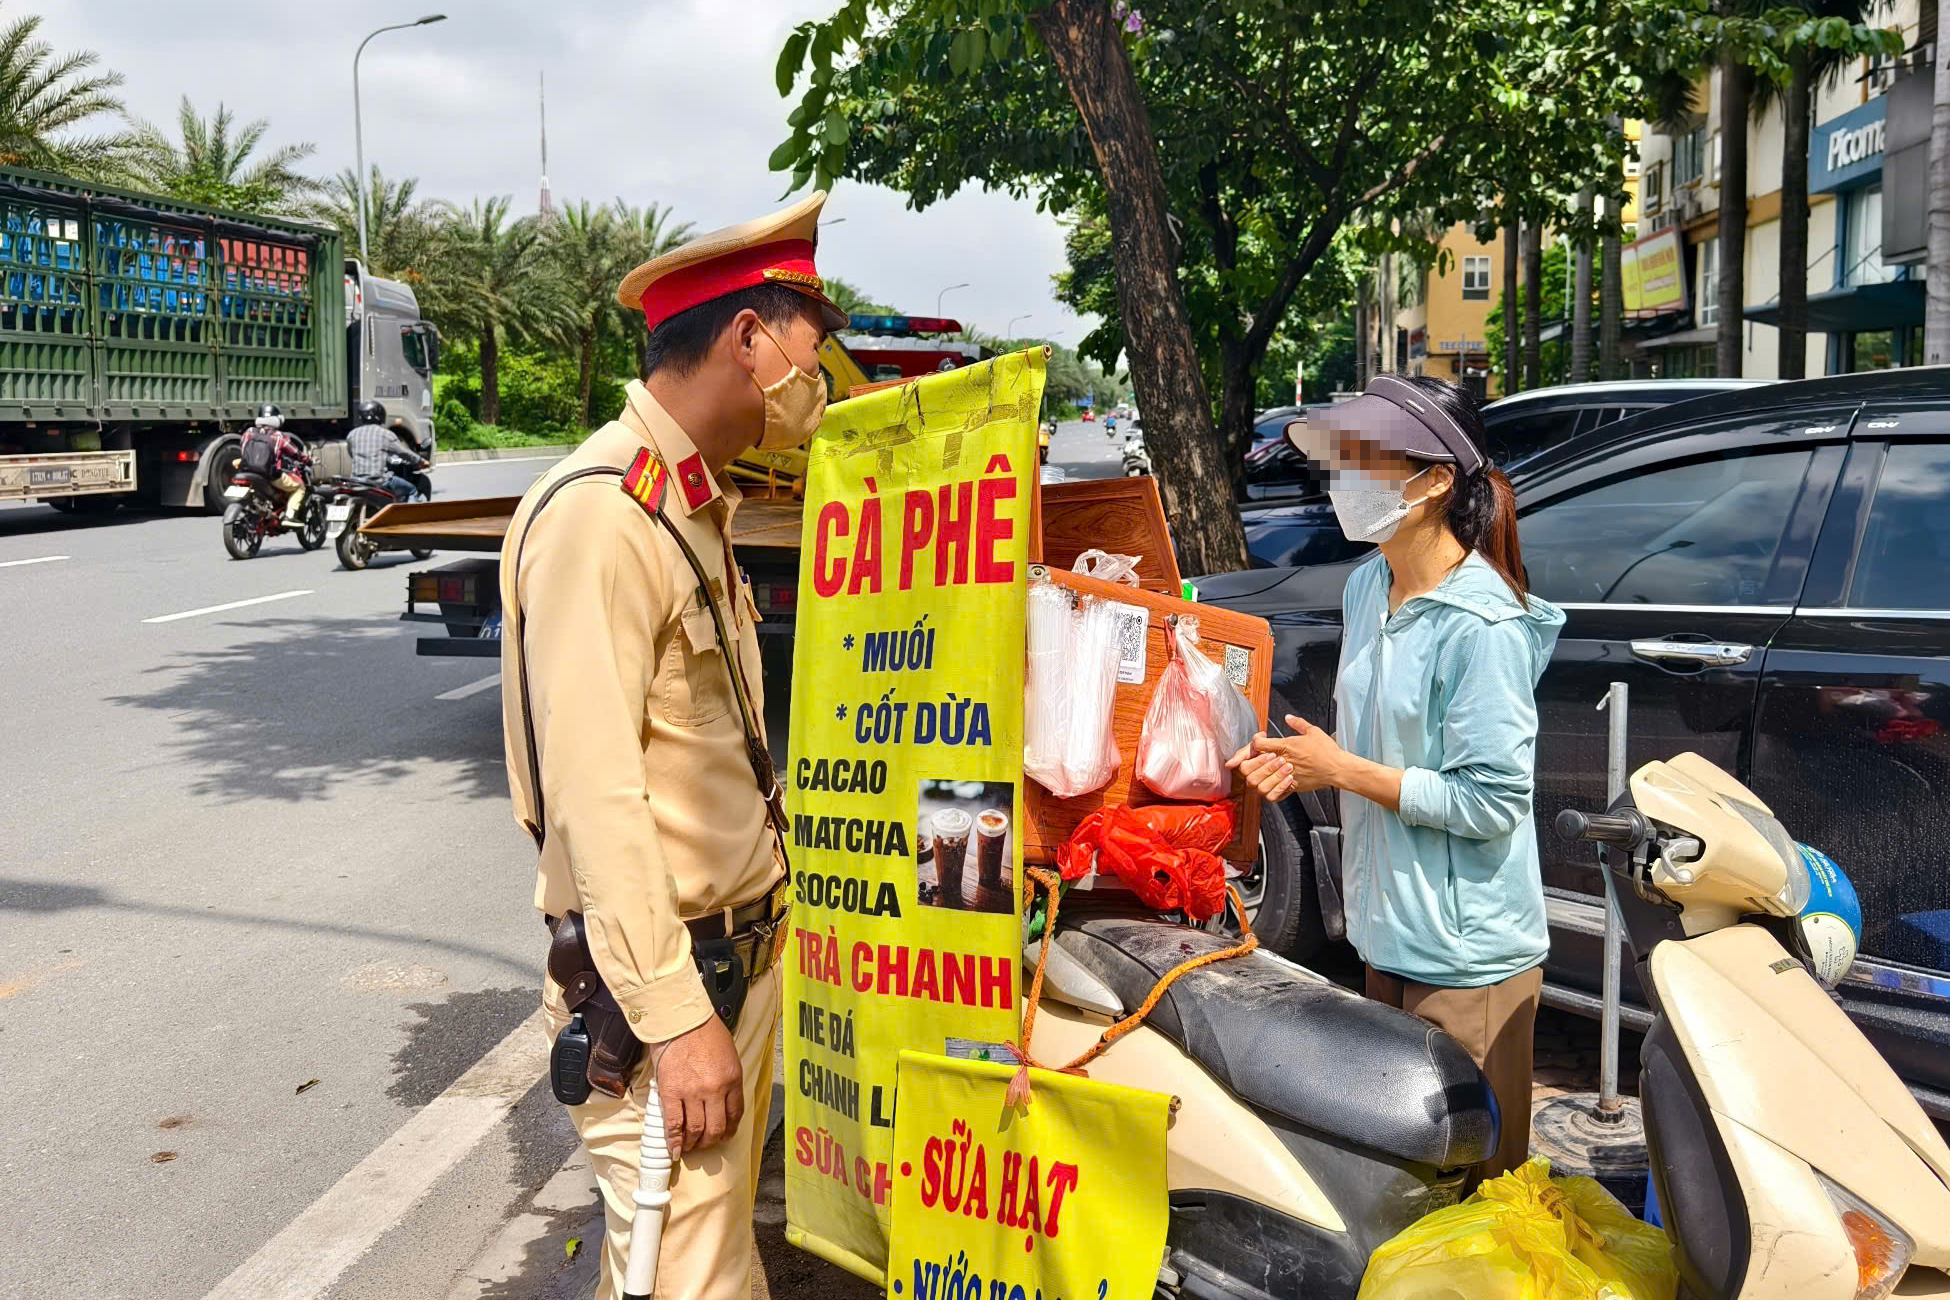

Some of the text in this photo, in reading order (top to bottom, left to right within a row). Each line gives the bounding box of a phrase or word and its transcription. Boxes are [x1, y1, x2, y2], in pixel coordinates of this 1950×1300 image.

[813, 454, 1017, 598] CÀ PHÊ
[862, 613, 936, 672] MUỐI
[855, 687, 992, 746] CỐT DỪA
[796, 757, 888, 795] CACAO
[794, 813, 910, 857] MATCHA
[795, 870, 902, 918] SOCOLA
[795, 926, 1013, 1011] TRÀ CHANH
[799, 1000, 855, 1059] ME ĐÁ
[799, 1058, 897, 1129] CHANH L
[795, 1126, 892, 1206] SỮA CH
[921, 1117, 1079, 1253] SỮA HẠT
